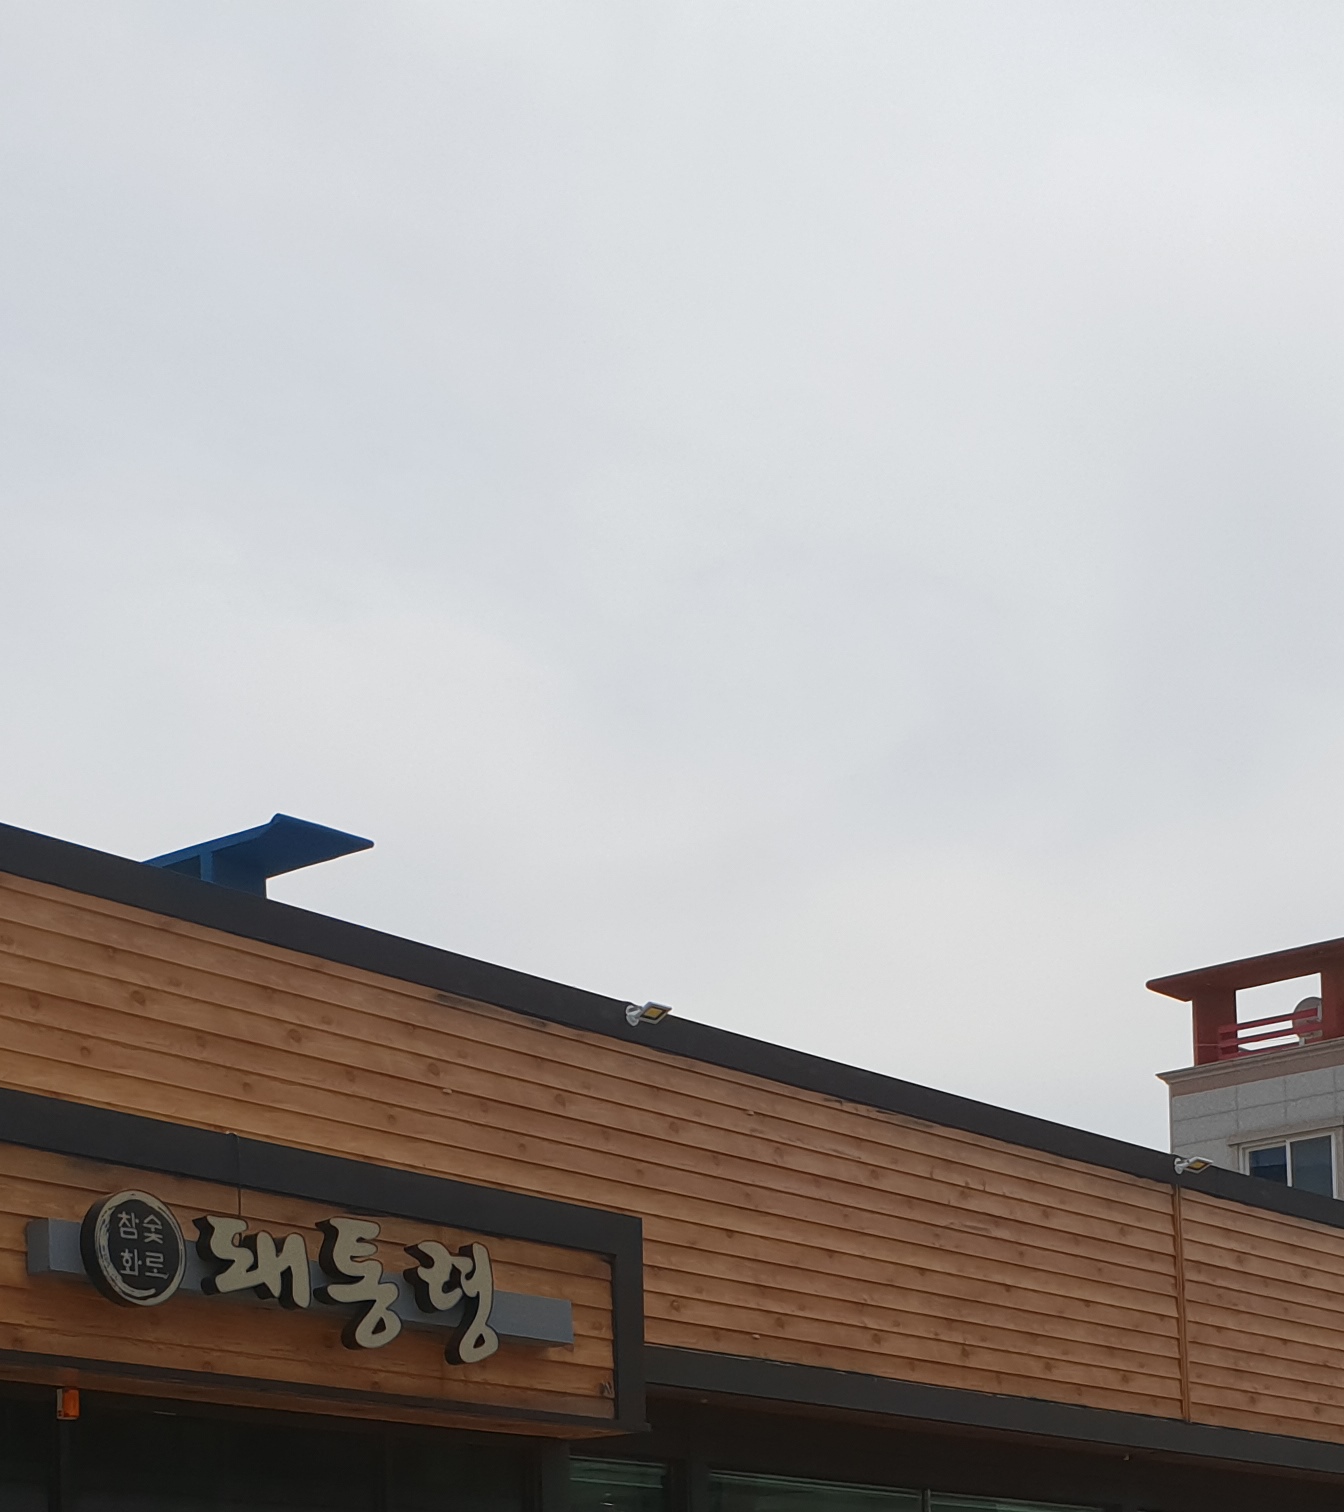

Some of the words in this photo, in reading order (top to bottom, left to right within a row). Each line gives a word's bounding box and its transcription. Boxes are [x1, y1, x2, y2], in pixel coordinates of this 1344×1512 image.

[117, 1210, 164, 1245] 참숯
[119, 1249, 169, 1281] 화로
[194, 1213, 500, 1367] 돼통령
